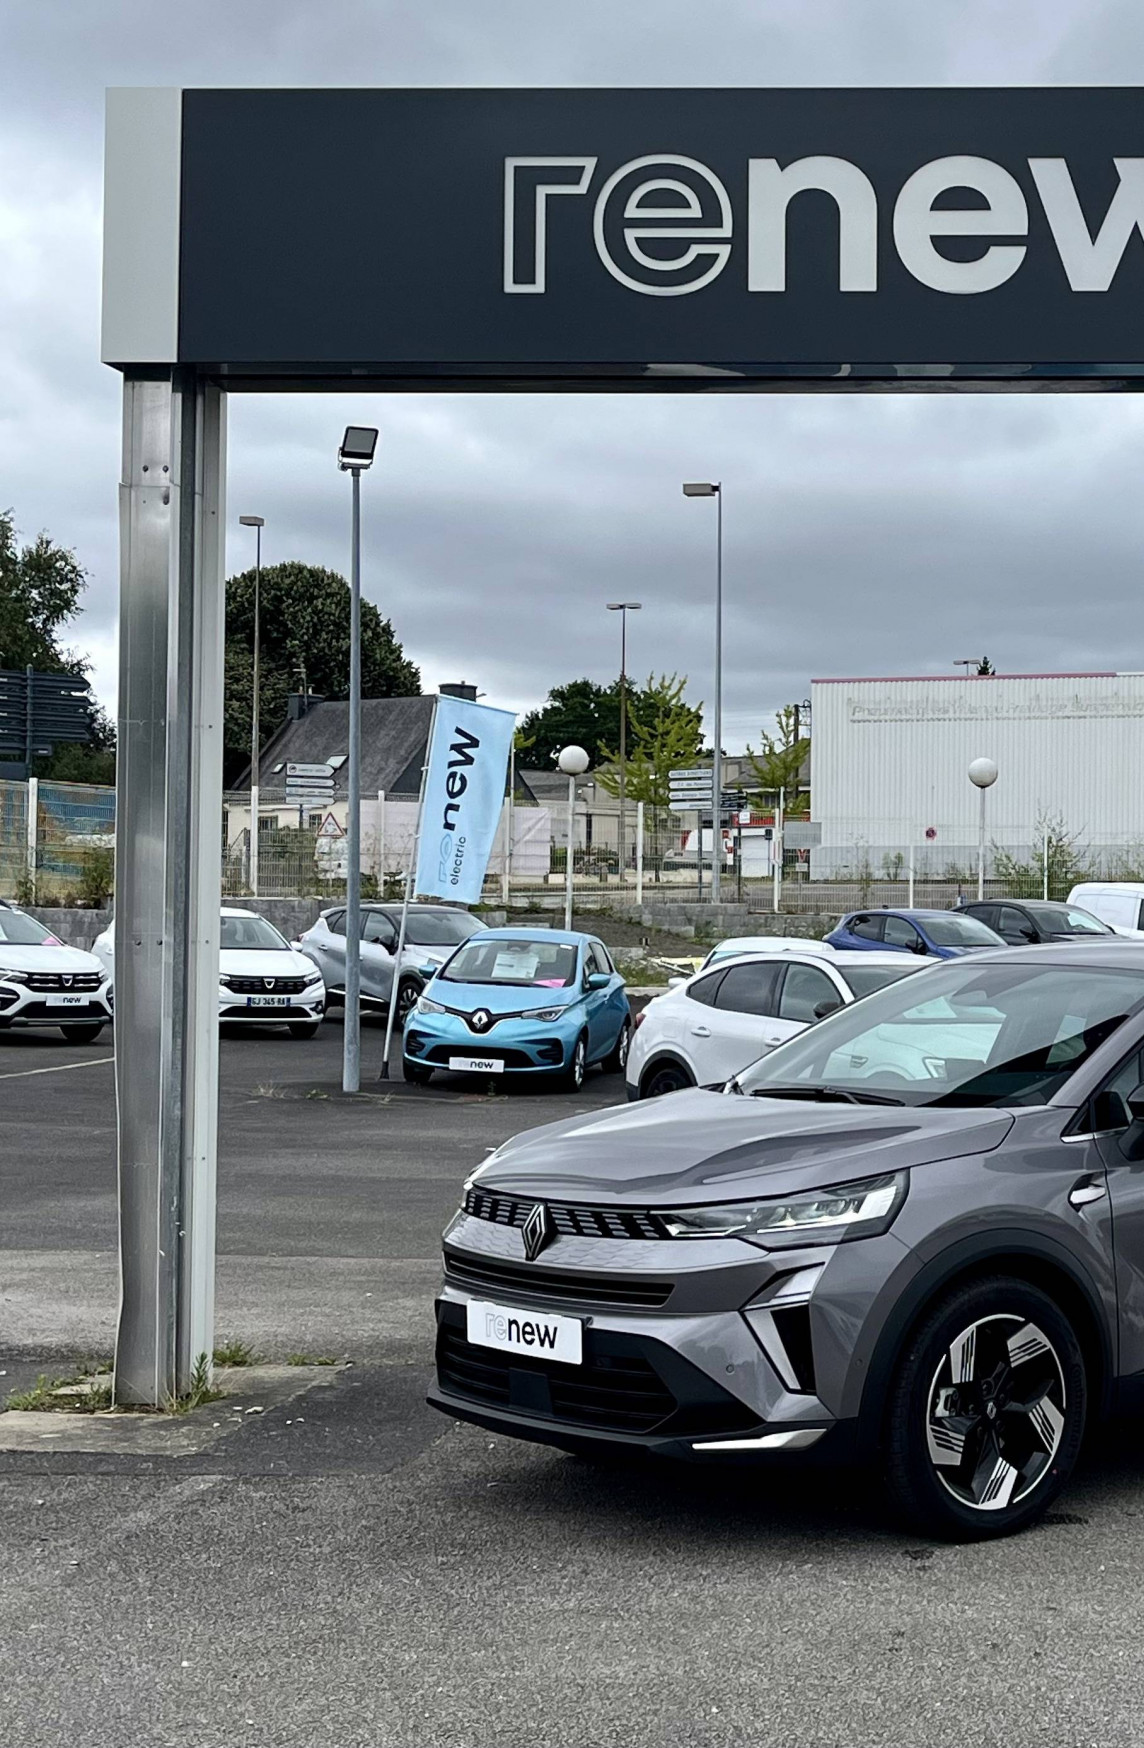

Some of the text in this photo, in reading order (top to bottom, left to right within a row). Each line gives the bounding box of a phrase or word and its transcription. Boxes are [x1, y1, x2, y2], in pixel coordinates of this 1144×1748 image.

[438, 726, 481, 882] renew
[451, 836, 467, 886] electric
[485, 1312, 558, 1349] renew
